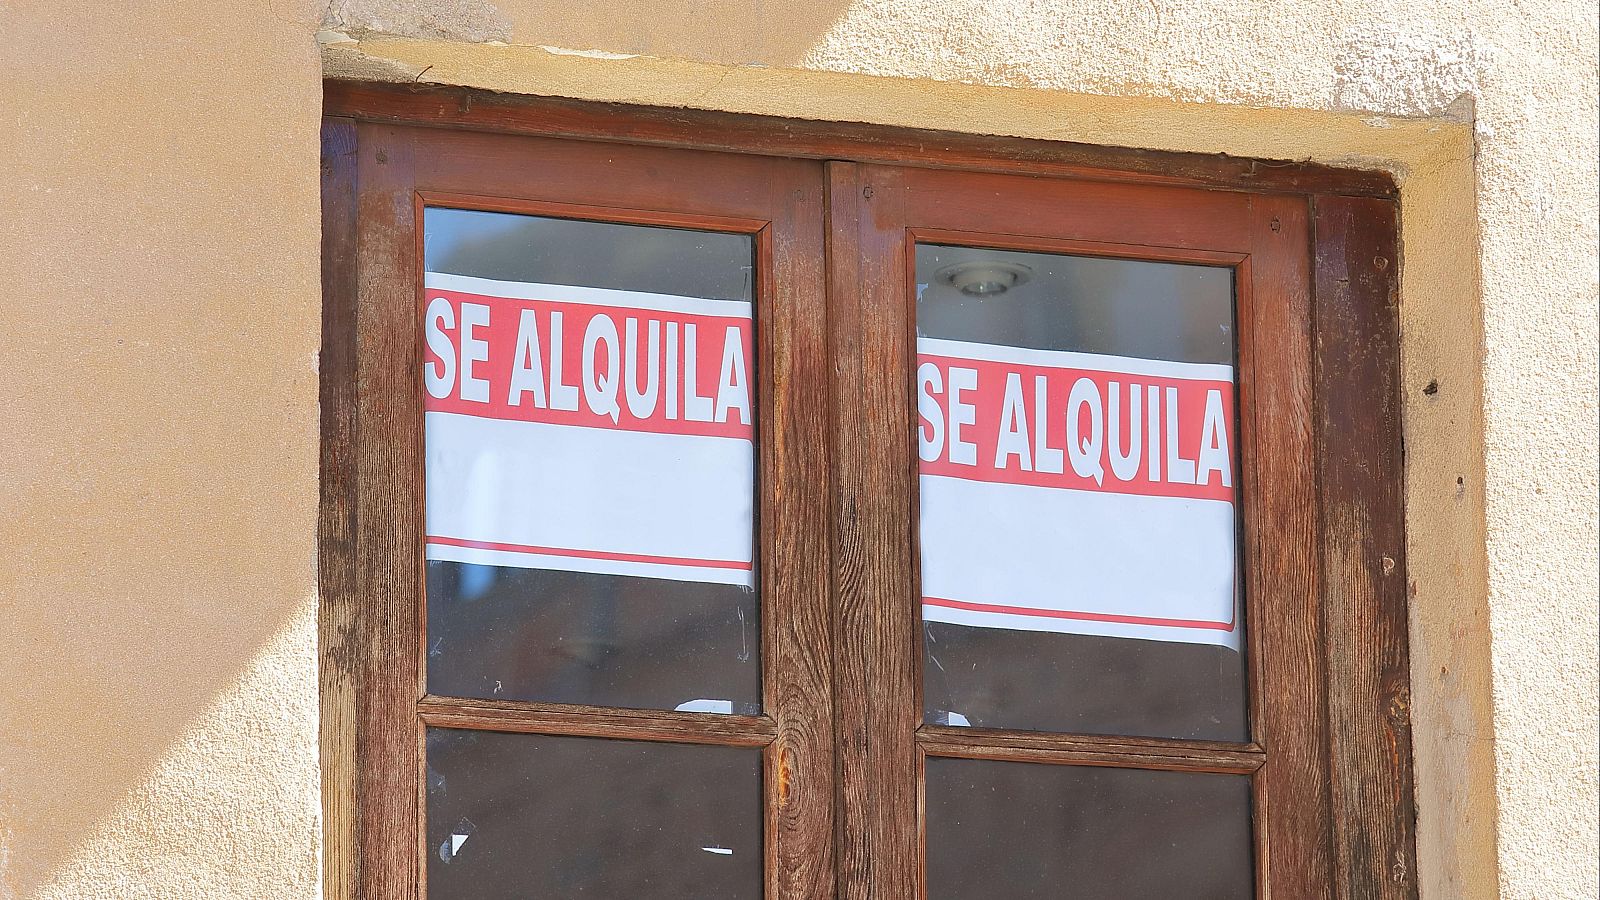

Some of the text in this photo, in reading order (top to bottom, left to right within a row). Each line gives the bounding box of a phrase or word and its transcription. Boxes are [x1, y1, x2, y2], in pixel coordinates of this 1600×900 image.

[425, 297, 752, 426] SE ALQUILA
[918, 362, 1233, 488] SE ALQUILA
